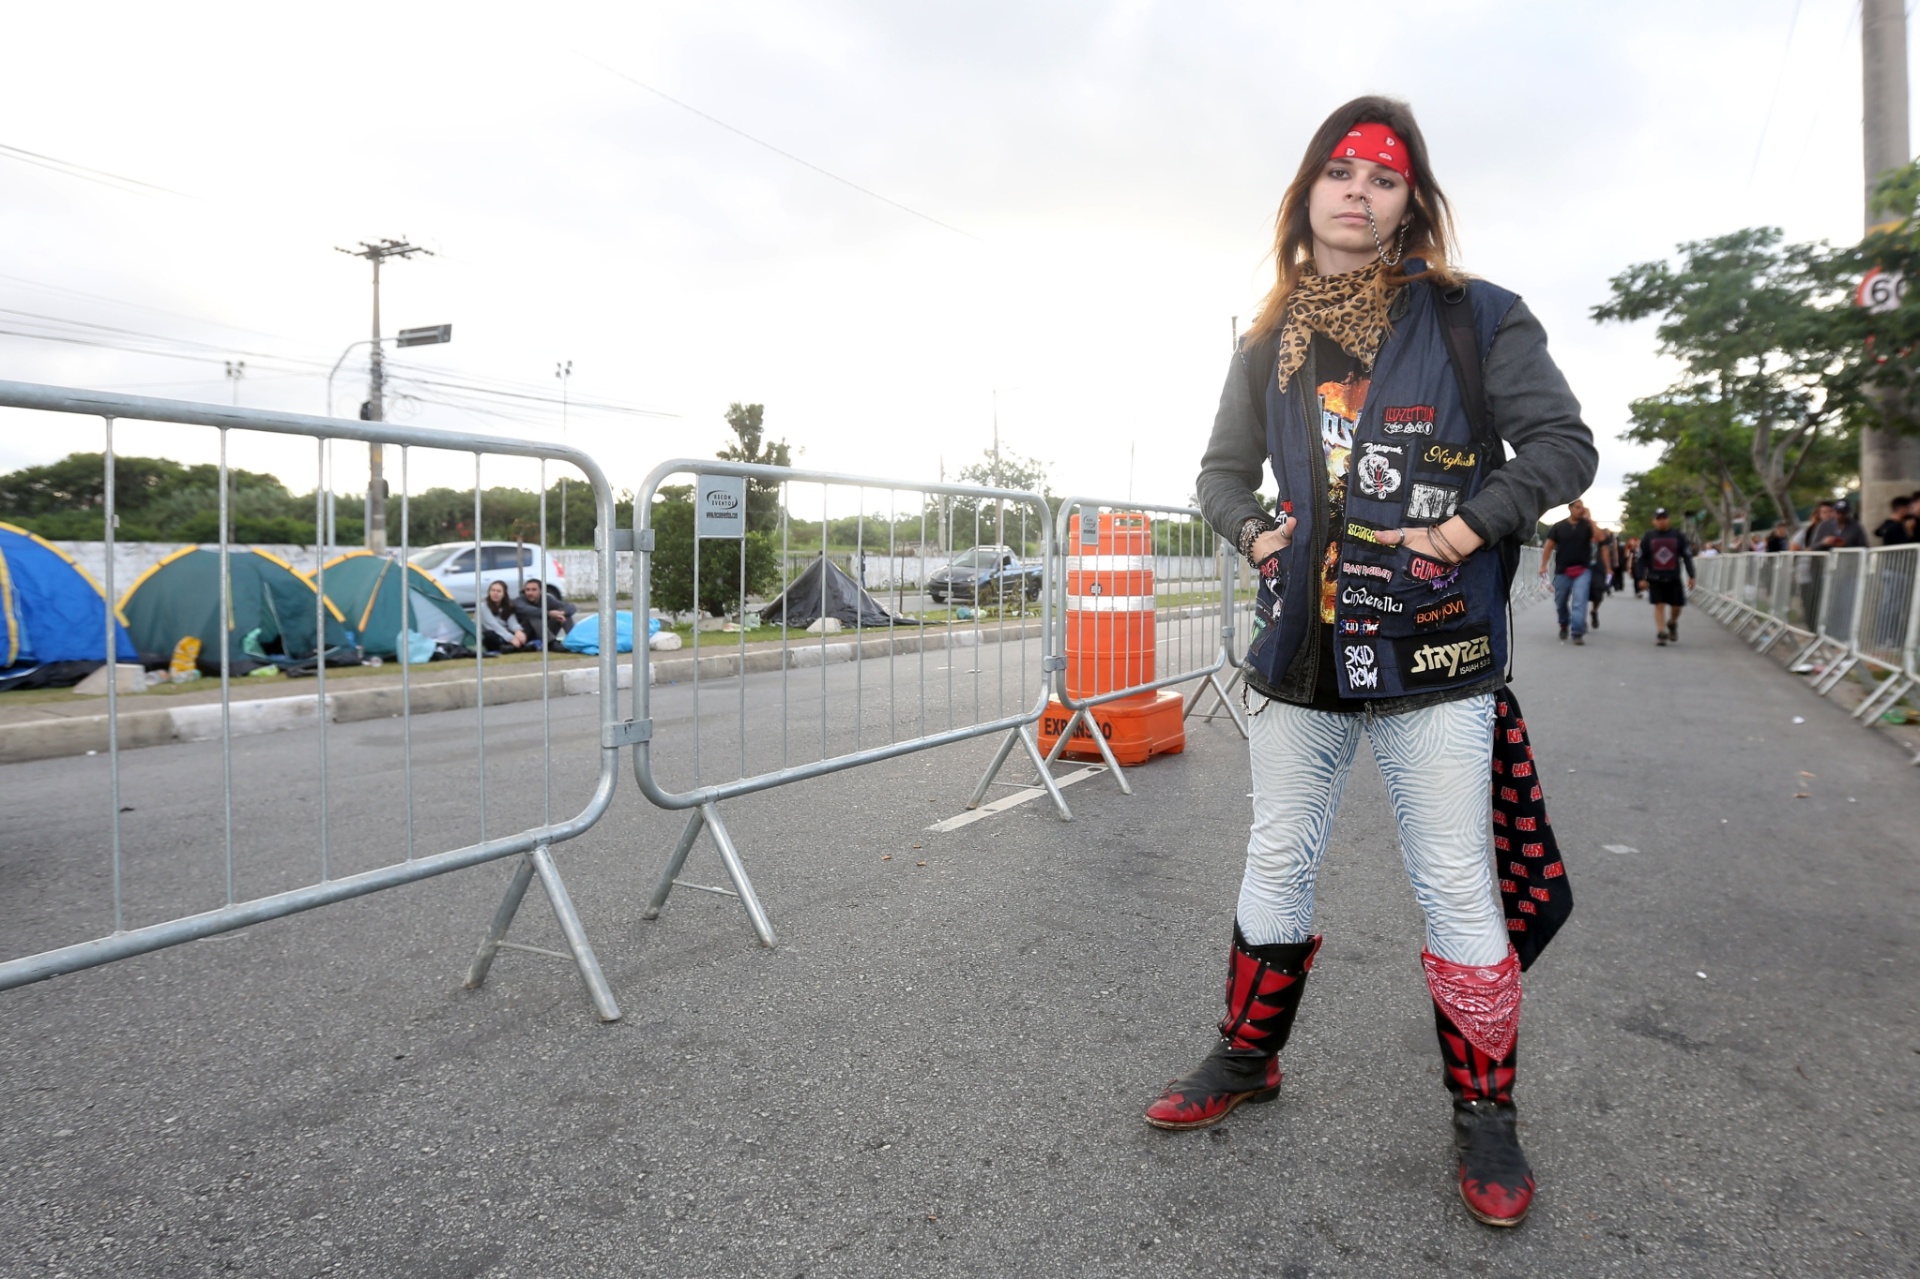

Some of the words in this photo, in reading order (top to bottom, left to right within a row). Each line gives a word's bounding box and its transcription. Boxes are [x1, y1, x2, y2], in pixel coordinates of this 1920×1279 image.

[1342, 586, 1403, 613] Cinderella
[1344, 644, 1375, 667] SKID
[1411, 635, 1490, 677] STRYPER
[1346, 664, 1379, 690] ROW
